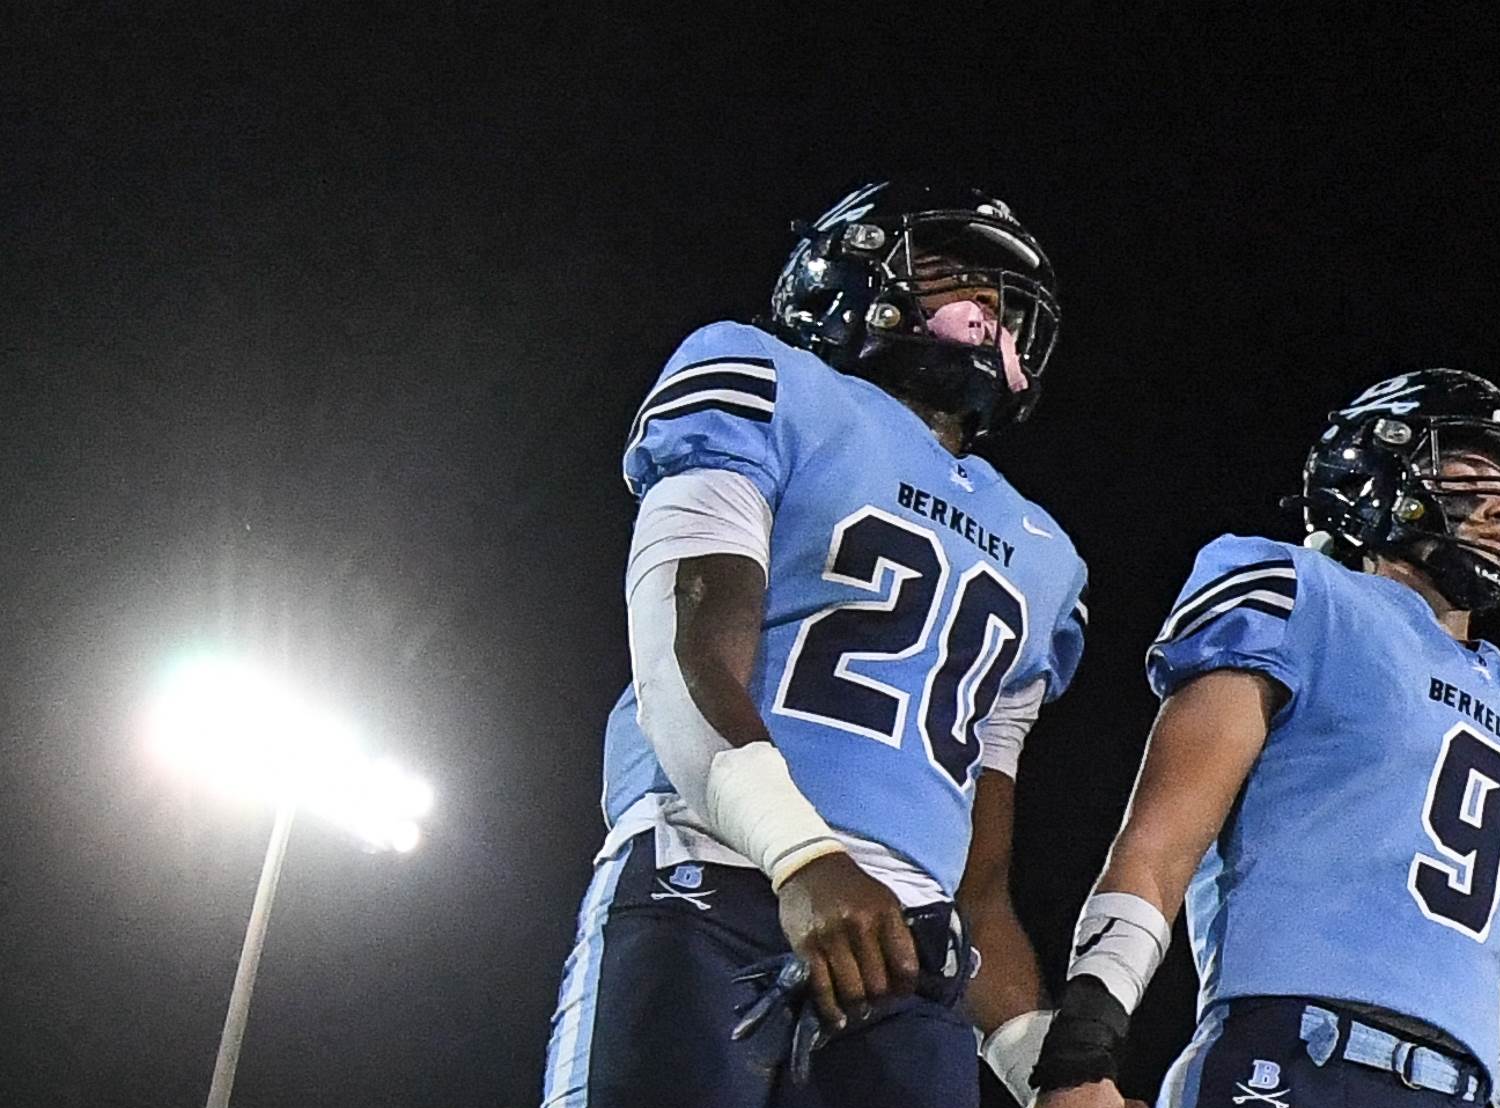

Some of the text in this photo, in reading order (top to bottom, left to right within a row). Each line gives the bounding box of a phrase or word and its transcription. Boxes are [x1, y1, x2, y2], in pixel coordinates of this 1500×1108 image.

[898, 481, 1016, 568] BERKELEY
[772, 504, 1028, 794] 20
[1247, 1059, 1281, 1090] B
